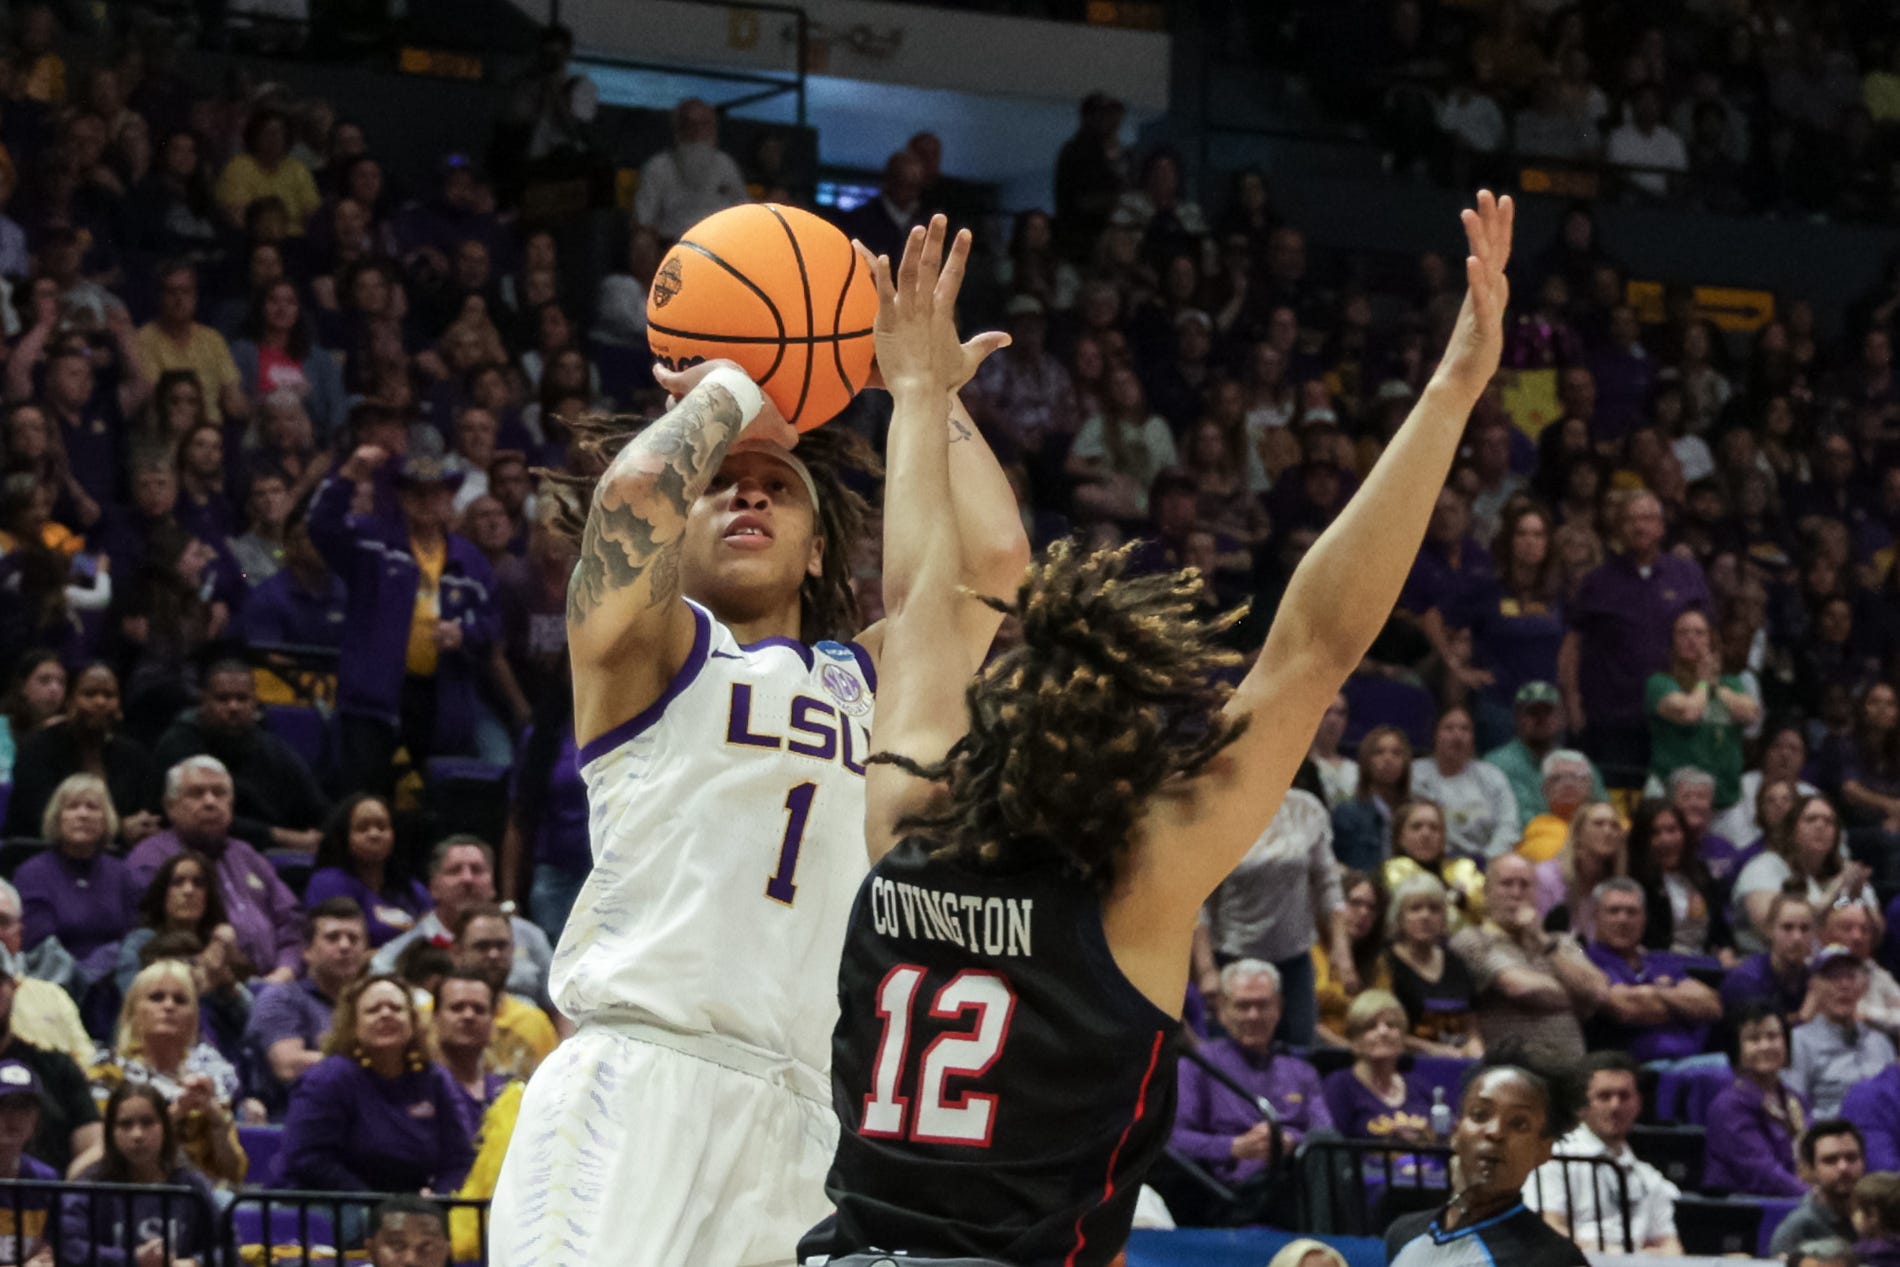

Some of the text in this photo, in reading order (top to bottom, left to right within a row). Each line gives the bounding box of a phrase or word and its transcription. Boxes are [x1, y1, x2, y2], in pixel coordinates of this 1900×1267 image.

[763, 780, 818, 908] 1
[871, 876, 1033, 957] COVINGTON
[858, 963, 1018, 1147] 12
